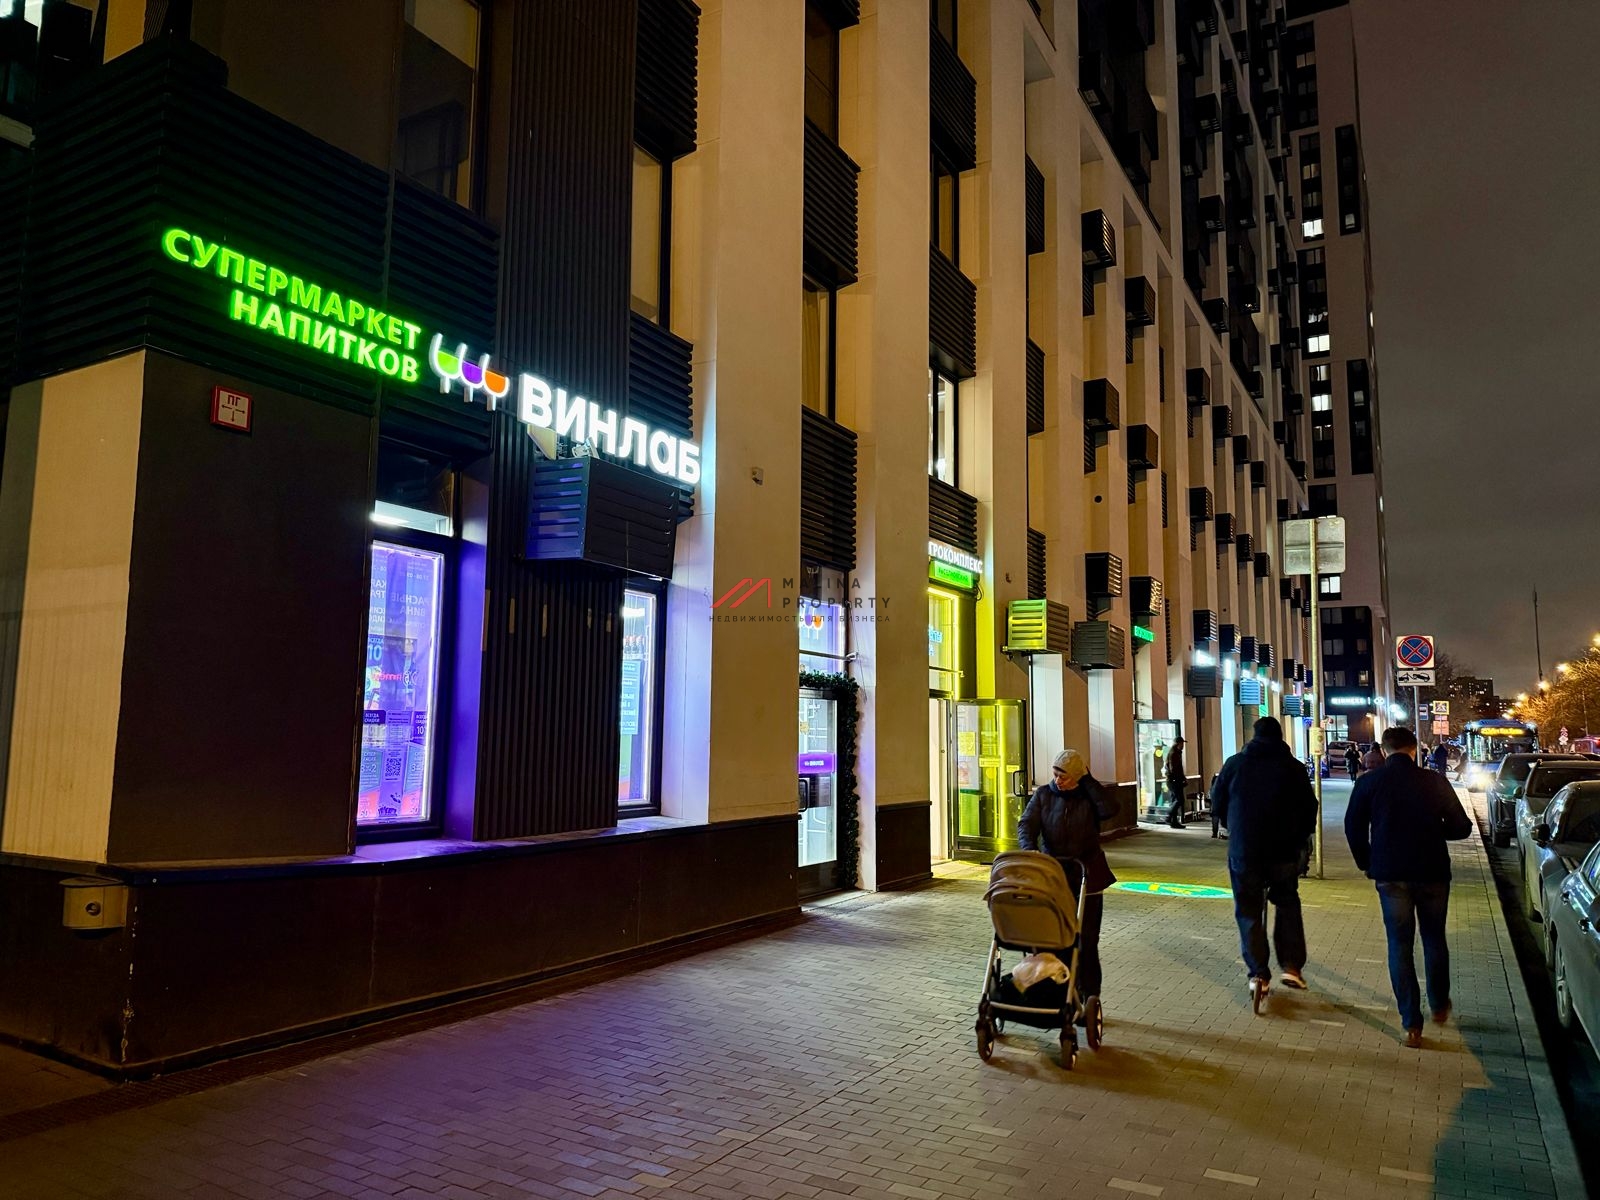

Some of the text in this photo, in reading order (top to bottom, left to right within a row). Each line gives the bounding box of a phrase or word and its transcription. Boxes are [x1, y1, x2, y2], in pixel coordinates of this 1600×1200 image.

[162, 228, 422, 350] СУПЕРМАРКЕТ
[232, 289, 421, 385] НАПИТКОВ
[227, 394, 241, 407] ПГ
